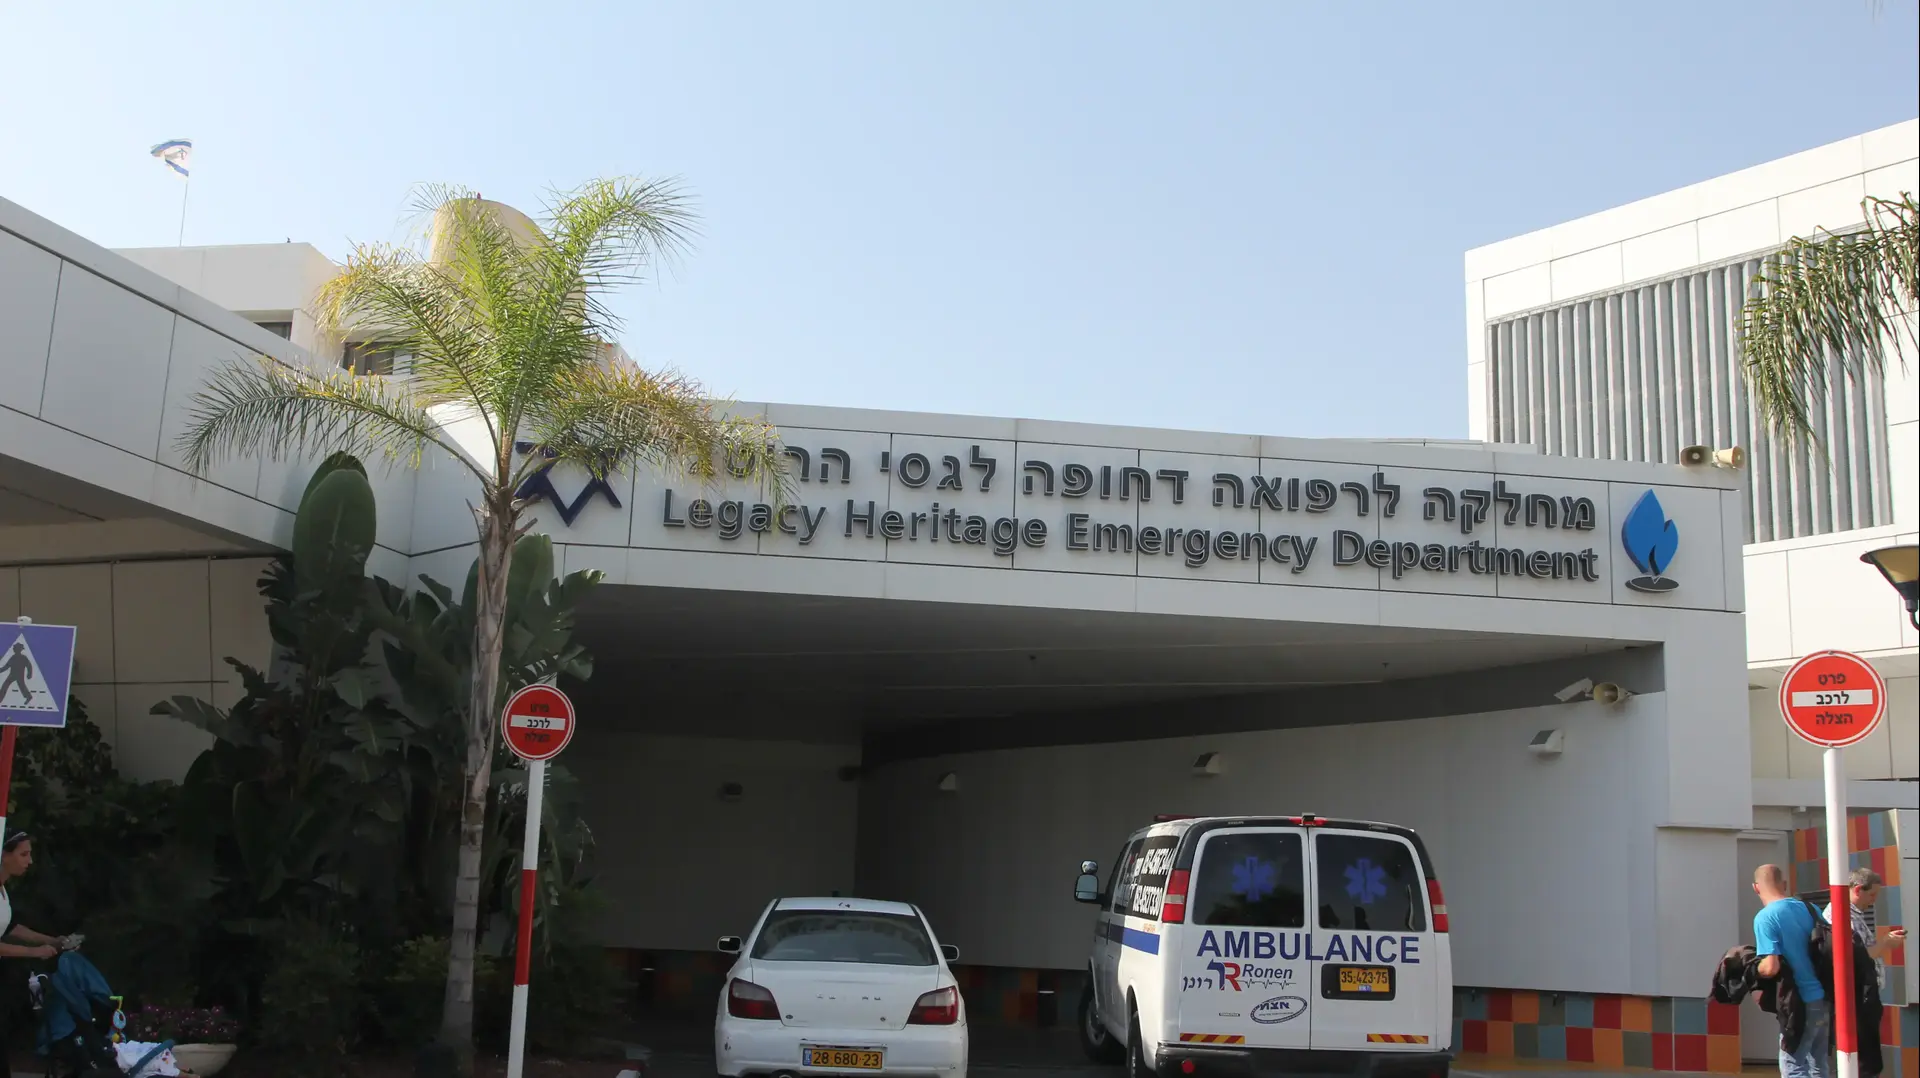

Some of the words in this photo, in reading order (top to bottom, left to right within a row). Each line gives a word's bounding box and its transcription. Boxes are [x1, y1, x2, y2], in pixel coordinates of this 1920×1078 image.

[880, 445, 997, 491] לגסי
[1023, 460, 1189, 504] דחופה
[1212, 472, 1400, 517] לרפואה
[1423, 480, 1596, 534] מחלקה
[663, 489, 827, 545] Legacy
[844, 499, 1047, 555] Heritage
[1066, 512, 1318, 573] Emergency
[1333, 529, 1599, 581] Department
[1817, 673, 1846, 685] פרט
[1816, 691, 1849, 705] לרכב
[526, 718, 550, 729] לרכב
[1815, 711, 1853, 725] הצלה
[1197, 930, 1420, 964] AMBULANCE
[1183, 976, 1213, 992] רונן
[1242, 963, 1293, 980] Ronen
